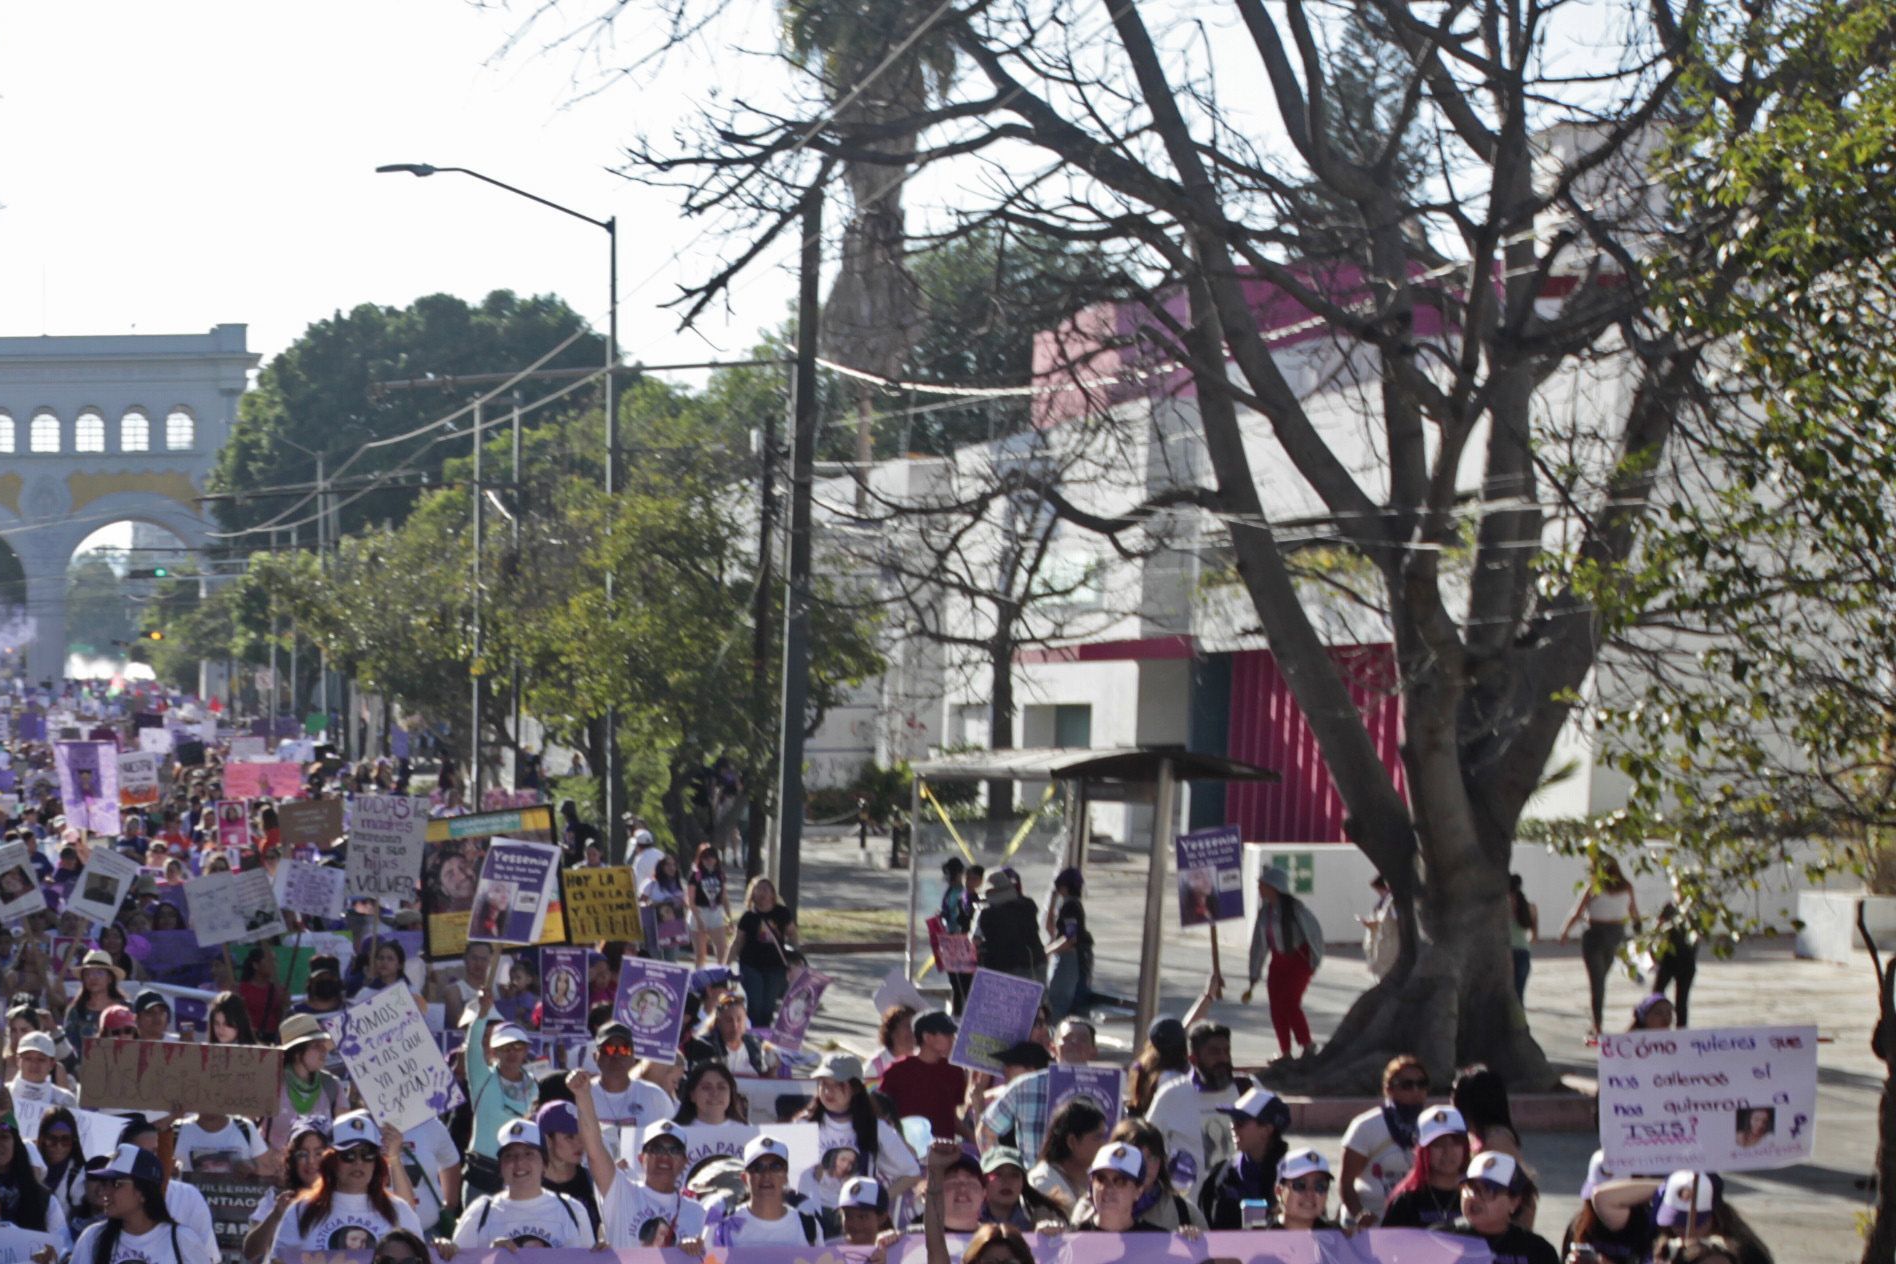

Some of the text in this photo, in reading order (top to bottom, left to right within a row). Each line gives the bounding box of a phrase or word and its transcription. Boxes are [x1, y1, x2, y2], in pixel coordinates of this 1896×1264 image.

[1179, 834, 1238, 852] Yessenia
[492, 849, 550, 866] Yessenia
[1690, 1034, 1757, 1058] quieres
[1767, 1034, 1804, 1052] que
[1607, 1074, 1640, 1090] nos
[1652, 1071, 1731, 1089] callemos
[1612, 1102, 1644, 1118] nos
[1771, 1090, 1790, 1106] a
